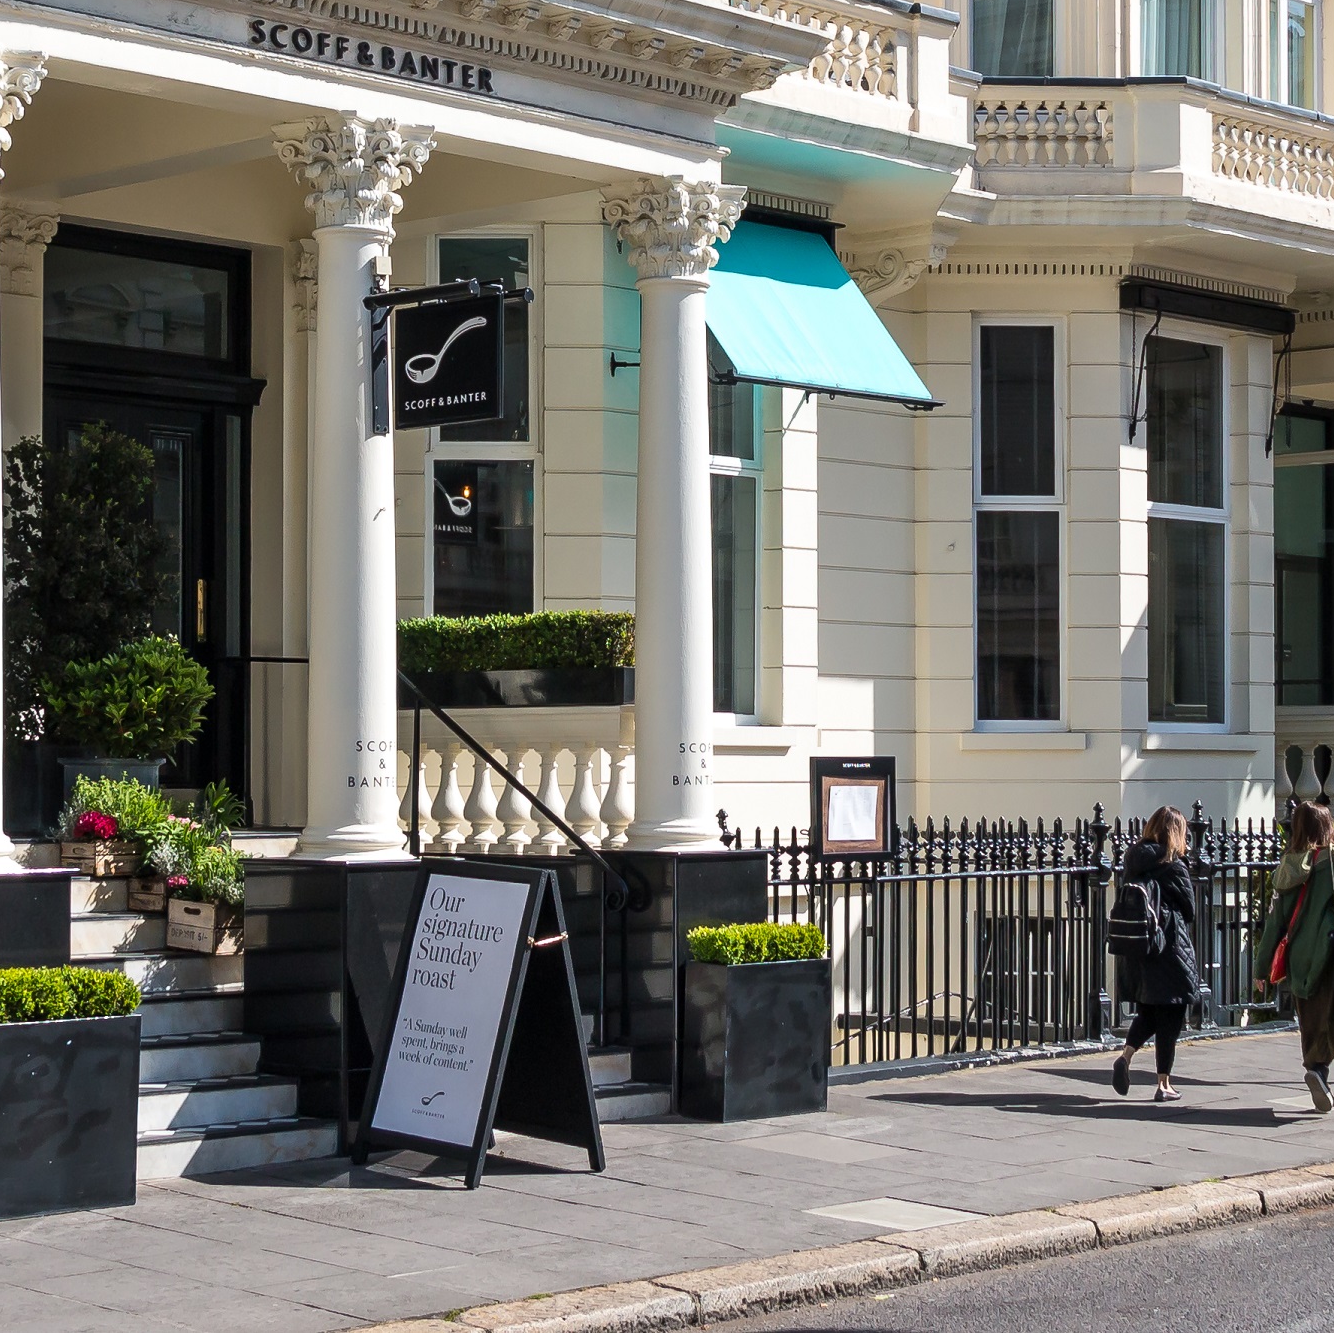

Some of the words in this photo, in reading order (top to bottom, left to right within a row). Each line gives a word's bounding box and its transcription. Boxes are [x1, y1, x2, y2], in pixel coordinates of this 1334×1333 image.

[355, 740, 394, 752] SCOF
[379, 758, 386, 769] &
[701, 758, 706, 768] &
[430, 887, 465, 913] Our
[422, 913, 503, 943] signature
[417, 937, 482, 973] Sunday
[412, 968, 457, 990] roast
[414, 1019, 447, 1038] Sunday
[449, 1026, 468, 1039] well
[401, 1036, 428, 1050] spent,
[430, 1037, 458, 1055] brings
[459, 1046, 465, 1055] a
[398, 1050, 421, 1063] week
[422, 1052, 434, 1065] of
